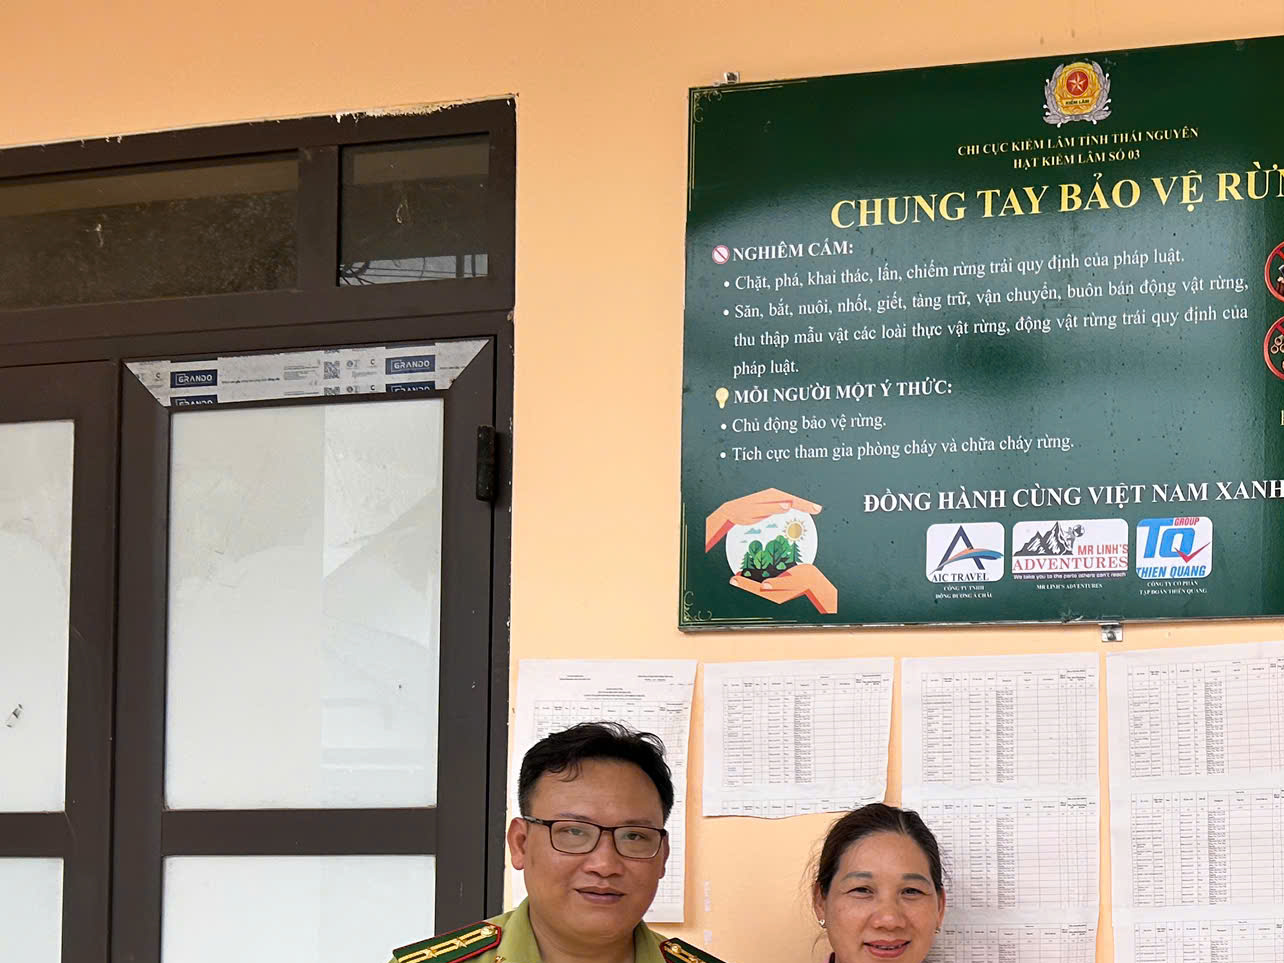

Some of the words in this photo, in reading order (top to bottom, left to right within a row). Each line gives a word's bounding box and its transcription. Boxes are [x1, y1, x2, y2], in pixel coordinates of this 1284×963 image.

[957, 144, 980, 156] CHI
[982, 142, 1009, 156] CỤC
[1047, 135, 1075, 149] LÂM
[1111, 131, 1142, 144] THÁI
[1145, 125, 1198, 141] NGUYÊN
[1013, 157, 1039, 171] HẠT
[1078, 150, 1106, 164] LÂM
[1127, 149, 1140, 160] 03
[830, 191, 967, 229] CHUNG
[976, 185, 1049, 219] TAY
[1057, 172, 1141, 213] BẢO
[1151, 169, 1204, 213] VỆ
[733, 240, 803, 262] NGHIÊM
[807, 237, 854, 257] CẤM:
[735, 275, 771, 292] Chặt,
[775, 272, 804, 292] phá,
[807, 269, 837, 286] khai
[840, 268, 874, 284] thác,
[877, 262, 903, 281] lấn,
[906, 259, 949, 279] chiếm
[953, 261, 986, 279] rừng
[989, 257, 1013, 274] trái
[1017, 259, 1044, 276] quy
[1047, 253, 1080, 273] định
[1084, 252, 1109, 268] của
[1113, 249, 1149, 270] pháp
[1154, 247, 1185, 266] luật.
[734, 304, 764, 319] Săn,
[768, 297, 794, 317] bắt,
[798, 299, 833, 315] nuôi,
[837, 293, 872, 313] nhốt,
[876, 290, 907, 314] giết,
[912, 293, 942, 311] tàng
[946, 291, 971, 306] trữ,
[976, 288, 1002, 307] vận
[1006, 281, 1062, 305] chuyển,
[1067, 282, 1103, 298] buôn
[1108, 280, 1134, 296] bán
[1139, 278, 1177, 297] động
[1181, 276, 1204, 295] vật
[1209, 274, 1249, 293] rừng,
[734, 332, 756, 347] thu
[760, 330, 790, 349] thập
[794, 325, 823, 344] mẫu
[828, 327, 849, 344] vật
[853, 325, 877, 341] các
[881, 323, 907, 339] loài
[911, 322, 943, 339] thực
[947, 320, 969, 338] vật
[973, 318, 1011, 336] rừng,
[1015, 315, 1052, 334] động
[1056, 313, 1079, 331] vật
[1083, 311, 1118, 330] rừng
[1122, 308, 1146, 325] trái
[1151, 311, 1180, 328] quy
[1184, 305, 1217, 325] định
[1222, 304, 1248, 320] của
[393, 358, 431, 370] GRANDO
[733, 360, 766, 379] pháp
[770, 358, 799, 376] luật.
[178, 374, 213, 384] GRANDO
[835, 382, 877, 402] MỘT
[880, 378, 892, 397] Ý
[895, 376, 952, 396] THỨC:
[763, 416, 798, 434] động
[830, 413, 847, 431] vệ
[850, 412, 887, 431] rừng.
[731, 446, 762, 461] Tích
[766, 448, 791, 463] cực
[794, 444, 828, 459] tham
[832, 442, 854, 461] gia
[857, 441, 901, 460] phòng
[903, 439, 937, 457] cháy
[940, 437, 958, 453] và
[961, 436, 995, 452] chữa
[999, 435, 1033, 453] cháy
[1037, 433, 1074, 452] rừng.
[863, 488, 932, 513] ĐỒNG
[938, 485, 1007, 510] HÀNH
[1012, 482, 1082, 508] CÙNG
[1087, 482, 1146, 509] VIỆT
[1151, 482, 1209, 503] NAM
[1174, 517, 1200, 526] GROUP
[1078, 545, 1094, 555] MR
[1097, 543, 1129, 555] LINH'S
[1012, 556, 1129, 571] ADVENTURES
[1136, 566, 1167, 578] THIEN
[1170, 565, 1207, 578] QUANG
[932, 573, 949, 582] AIC
[951, 572, 989, 582] TRAVEL
